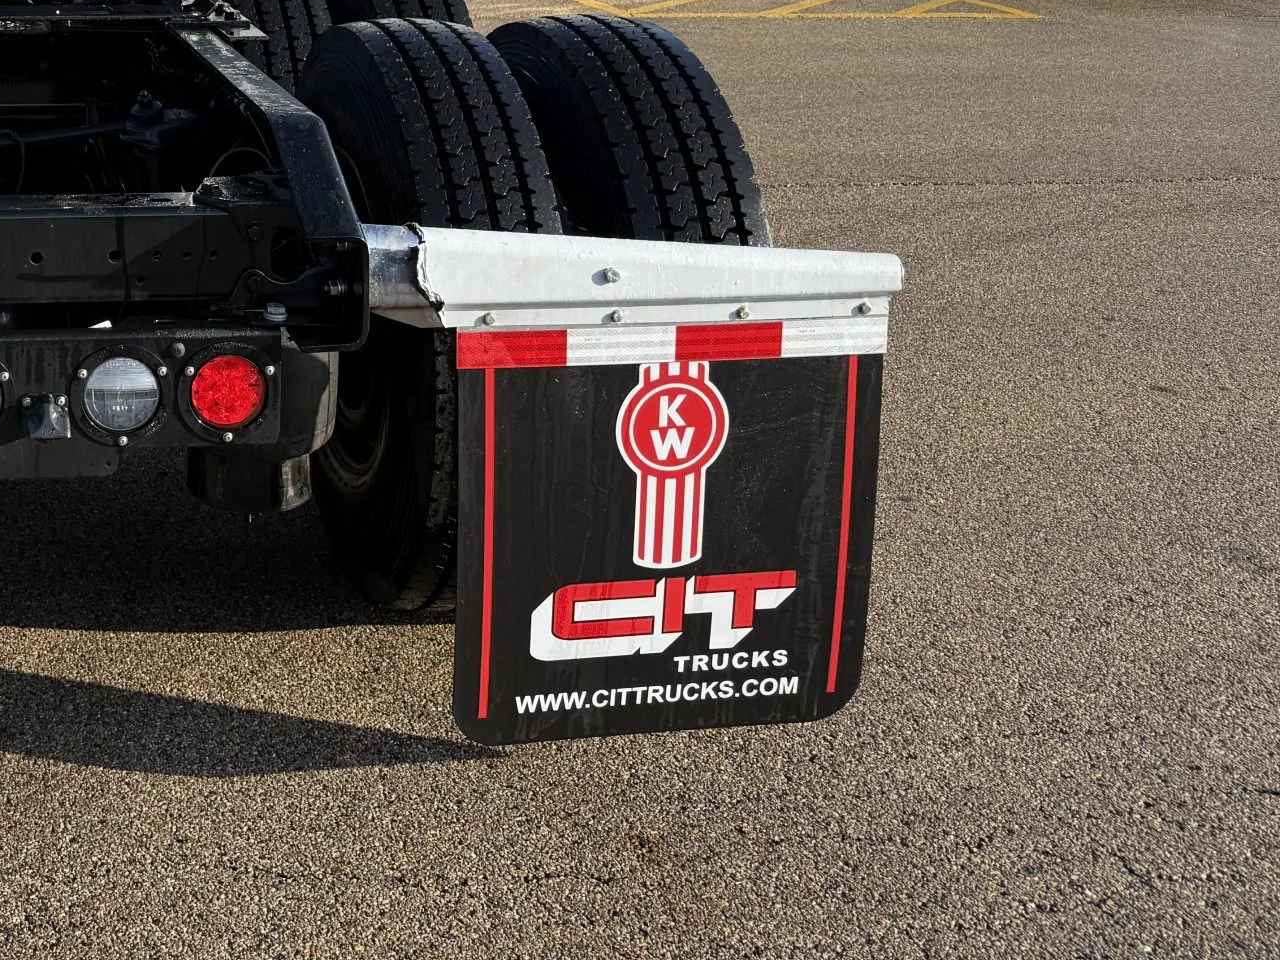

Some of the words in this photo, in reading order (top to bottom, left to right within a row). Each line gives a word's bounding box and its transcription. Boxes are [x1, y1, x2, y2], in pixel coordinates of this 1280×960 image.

[529, 570, 797, 661] CIT
[673, 648, 789, 673] TRUCKS
[515, 675, 800, 714] WWW.CITTRUCKS.COM
